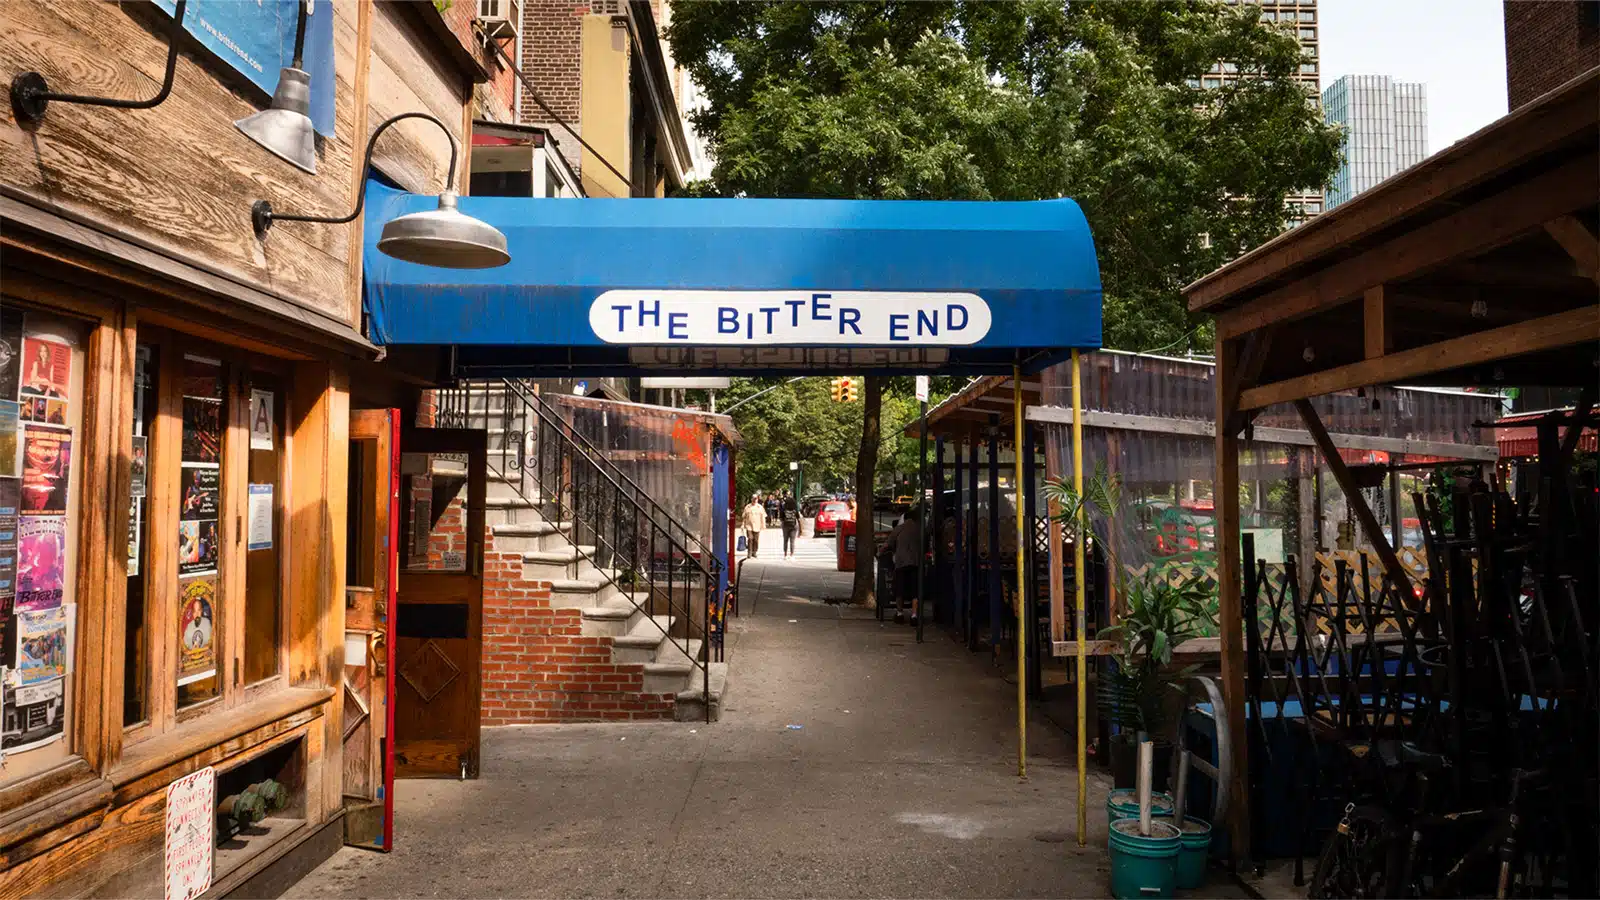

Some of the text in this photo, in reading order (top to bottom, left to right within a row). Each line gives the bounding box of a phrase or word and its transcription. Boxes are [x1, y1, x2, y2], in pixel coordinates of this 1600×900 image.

[200, 17, 263, 73] www.bitterend.com
[612, 294, 969, 341] THE BITTER END
[254, 398, 269, 433] A
[18, 590, 51, 604] BITTER
[176, 787, 205, 813] SPRINKLER
[172, 800, 207, 830] CONNECTION
[173, 842, 188, 861] FIRST
[175, 850, 204, 876] SPRINKLER
[182, 870, 196, 887] ONLY
